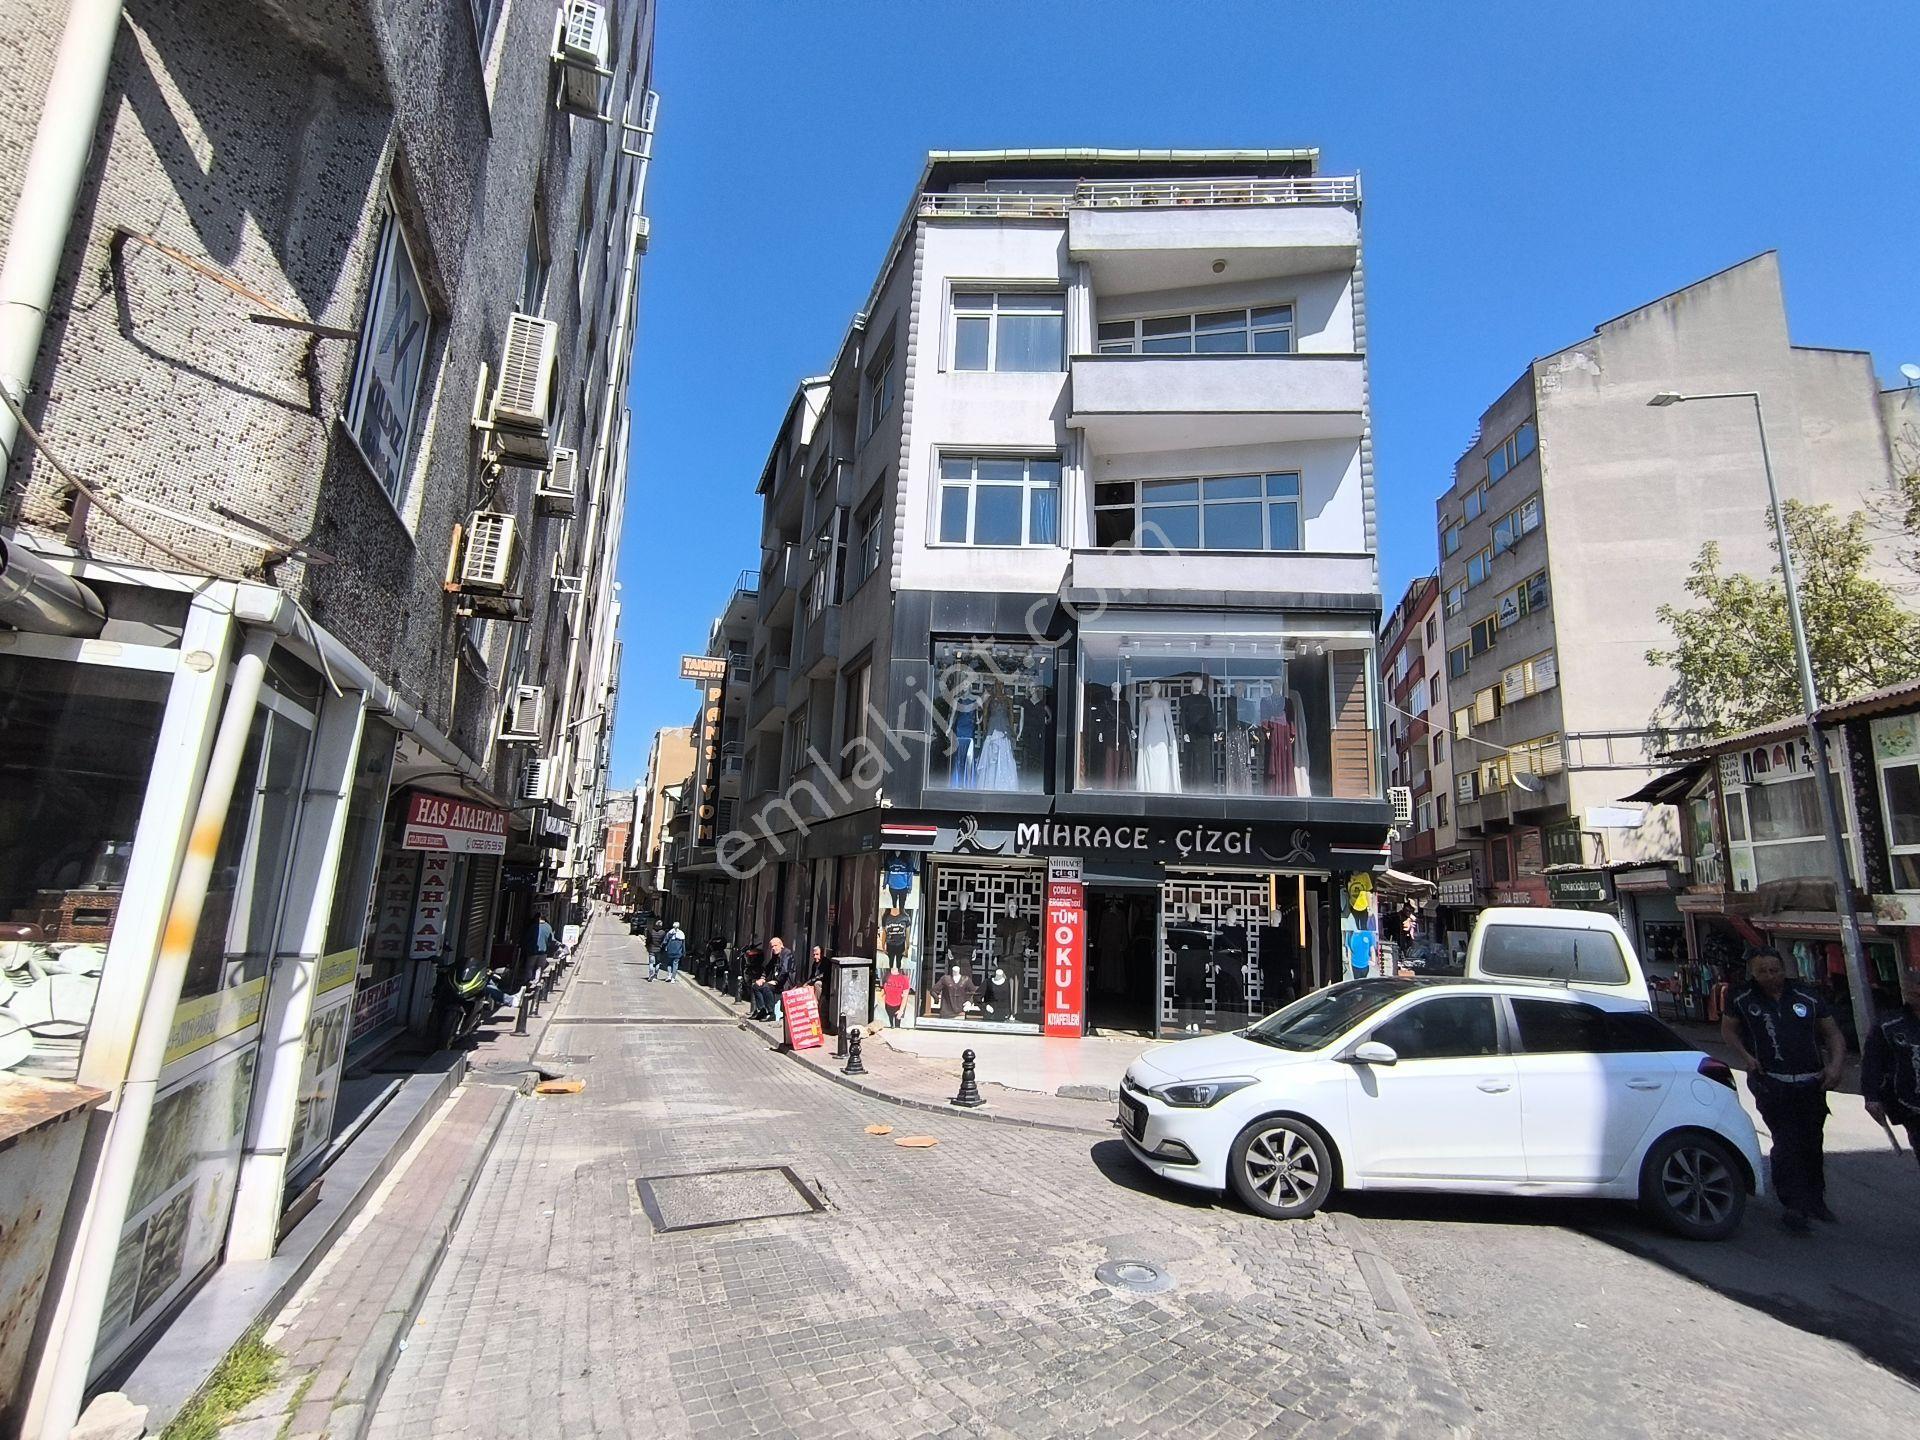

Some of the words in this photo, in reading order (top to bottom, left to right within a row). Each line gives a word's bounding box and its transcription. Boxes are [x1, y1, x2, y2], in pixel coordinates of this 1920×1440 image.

[416, 798, 449, 826] HAS
[450, 805, 505, 833] ANAHTAR
[1017, 819, 1149, 850] MİHRACE
[1176, 825, 1253, 858] ÇİZGİ
[414, 851, 450, 952] NAHTAR
[1050, 909, 1078, 924] TÜM
[1054, 926, 1074, 1010] OKUL
